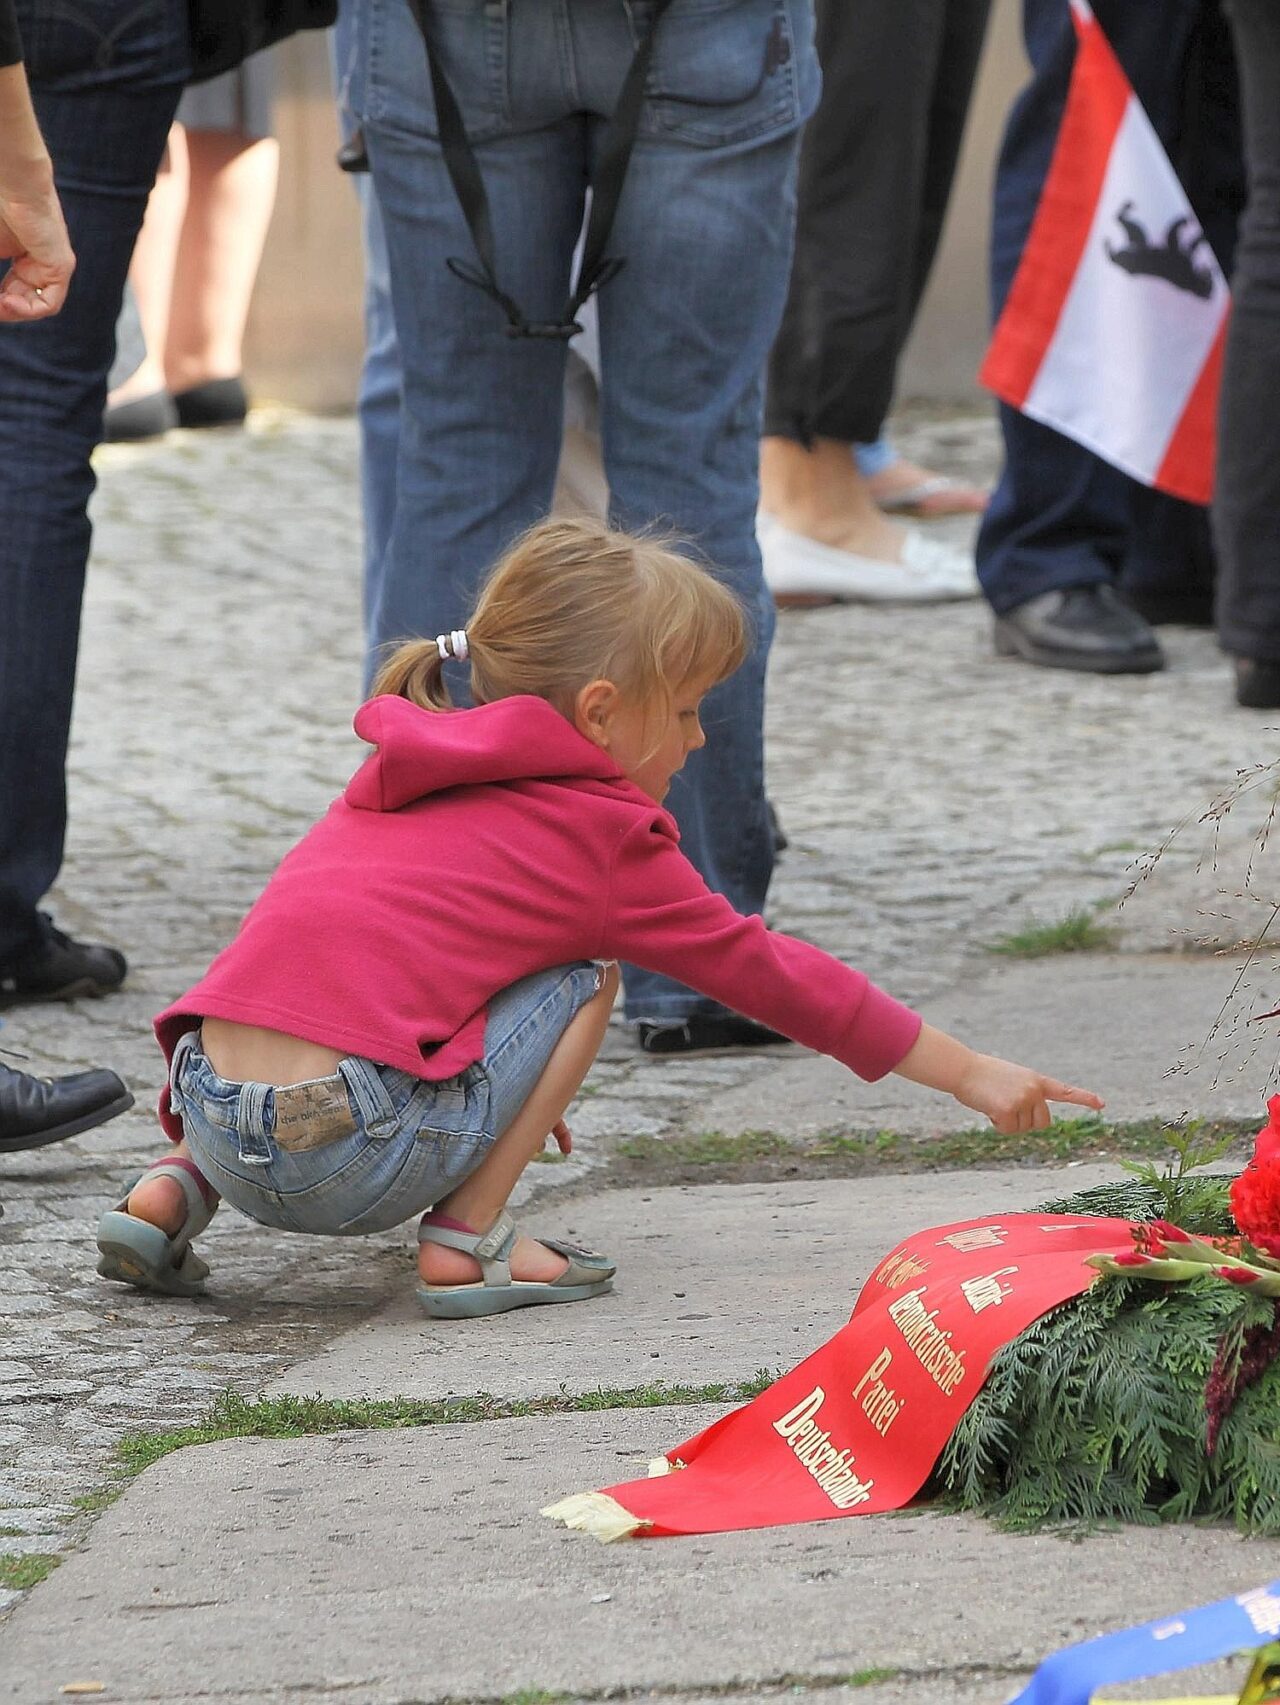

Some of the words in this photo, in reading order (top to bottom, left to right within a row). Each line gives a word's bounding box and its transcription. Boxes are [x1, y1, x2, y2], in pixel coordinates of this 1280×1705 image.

[851, 1346, 906, 1437] Partei
[888, 1286, 966, 1396] demokratische
[772, 1385, 874, 1509] Deutschlands
